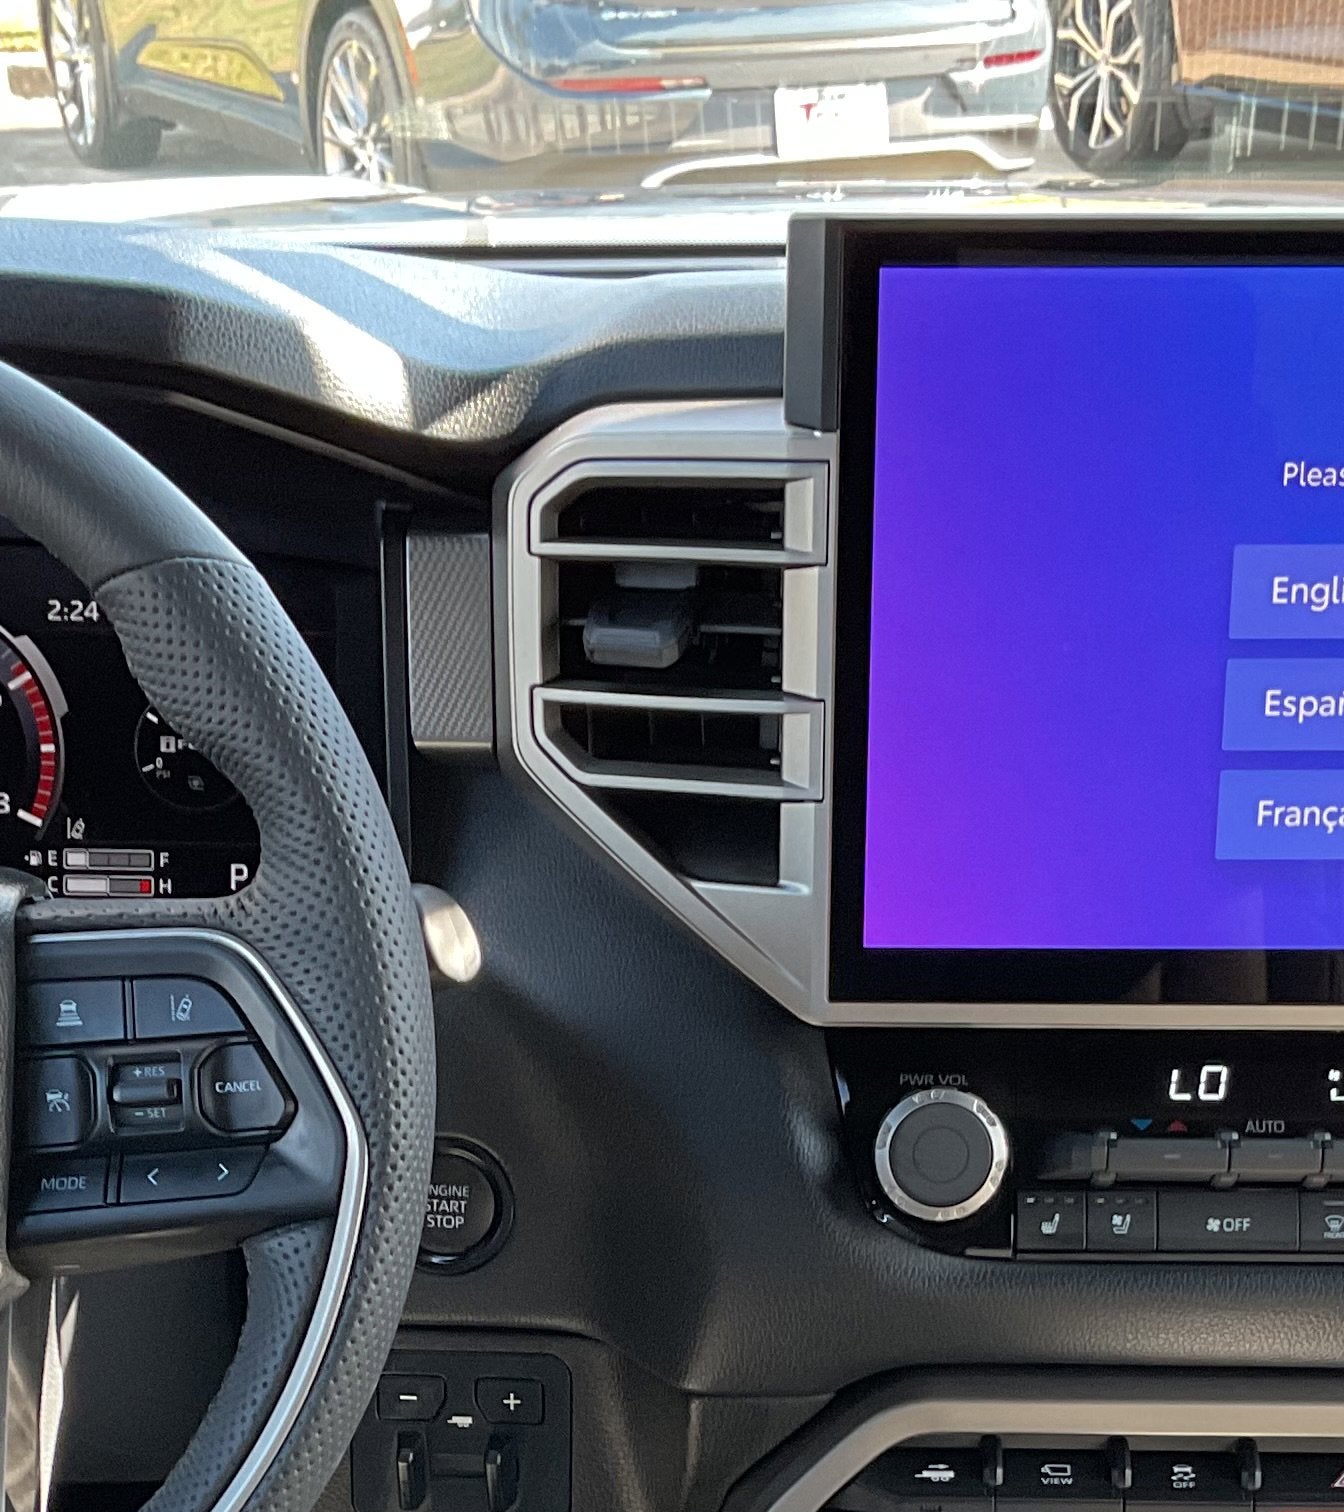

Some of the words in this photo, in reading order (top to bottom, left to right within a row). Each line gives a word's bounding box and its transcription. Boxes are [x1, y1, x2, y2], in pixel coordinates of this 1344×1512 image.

[47, 599, 100, 622] 2:24
[47, 850, 58, 867] E
[159, 851, 170, 868] F
[230, 863, 249, 891] P
[159, 878, 173, 894] H
[215, 1079, 263, 1095] CANCEL
[899, 1073, 935, 1087] PWR
[938, 1073, 969, 1087] VOL
[1245, 1119, 1286, 1135] AUTO
[41, 1174, 87, 1192] MODE
[427, 1184, 471, 1198] NGINE
[426, 1214, 465, 1230] STOP
[1222, 1217, 1252, 1233] OFF
[1040, 1476, 1073, 1486] VIEW
[1172, 1480, 1196, 1489] OFF
